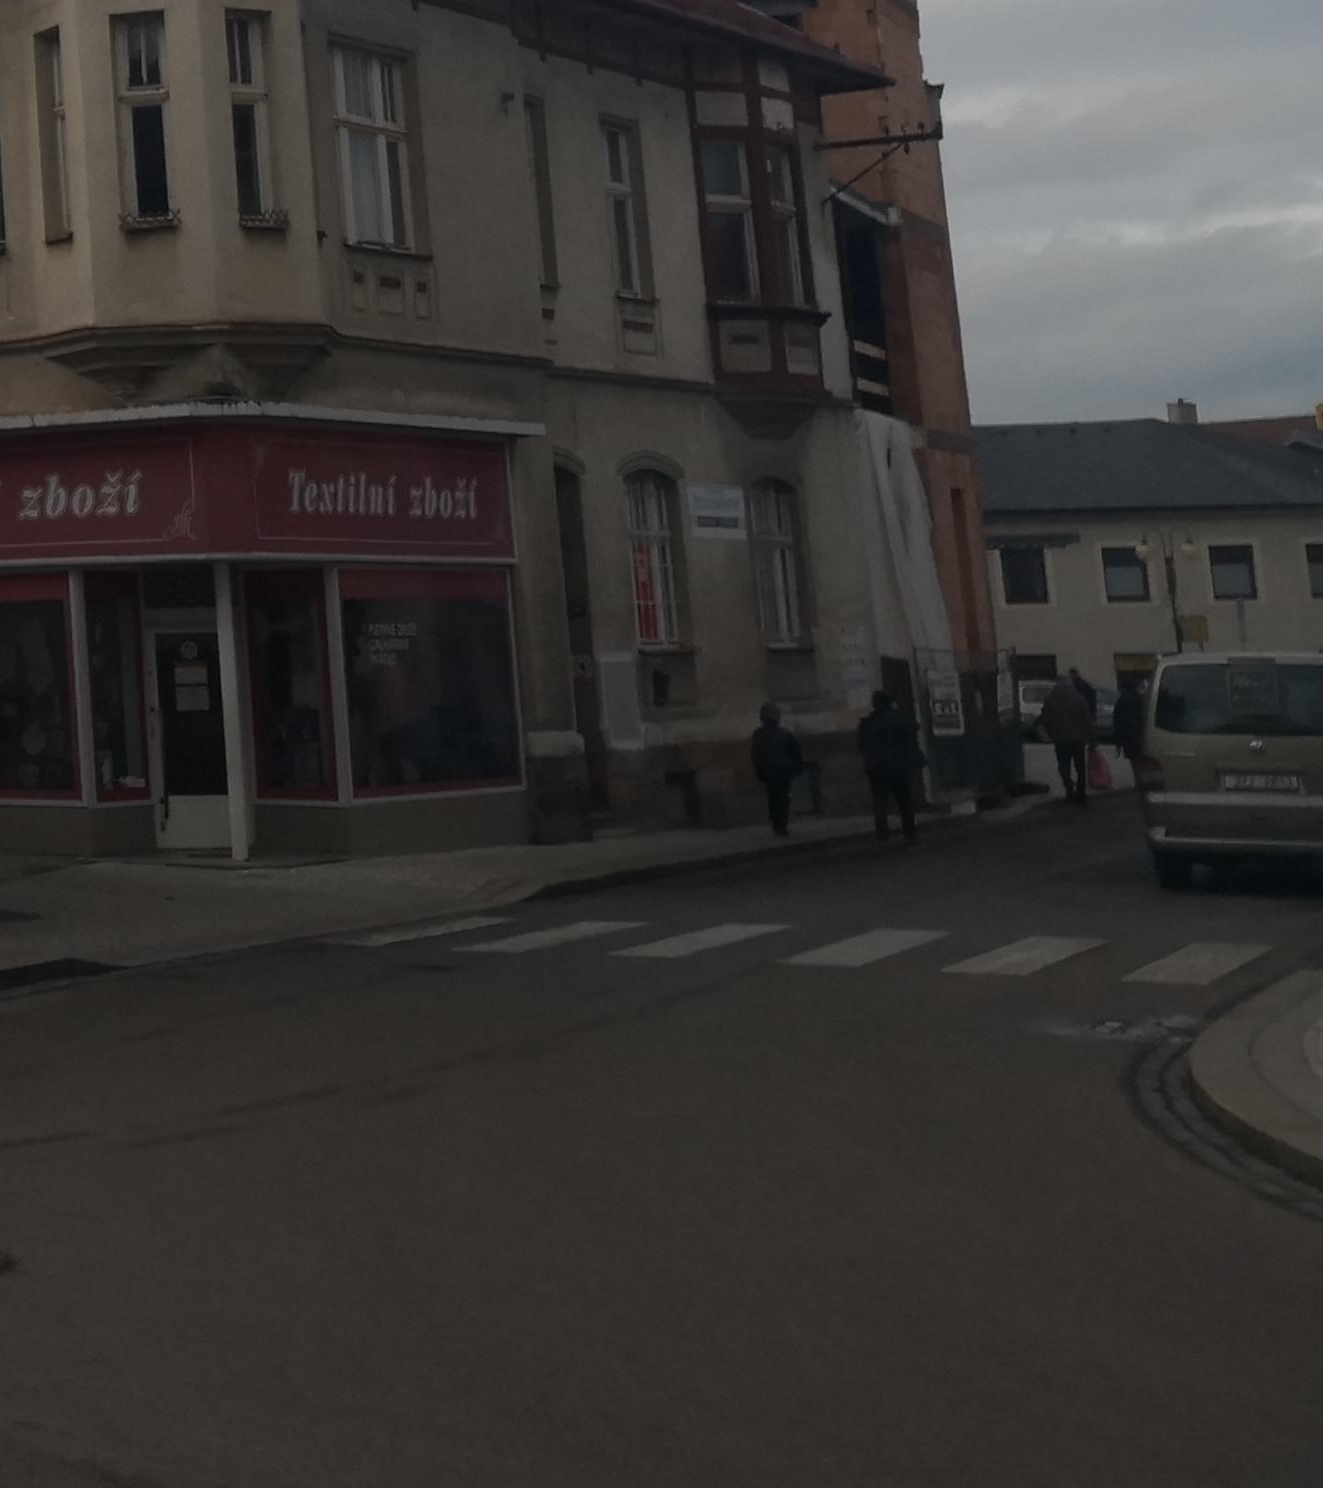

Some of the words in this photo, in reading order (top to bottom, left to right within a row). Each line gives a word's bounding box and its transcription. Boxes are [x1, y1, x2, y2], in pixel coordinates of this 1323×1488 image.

[17, 468, 143, 521] zboží
[287, 467, 398, 516] Textilní
[409, 473, 478, 519] zboží
